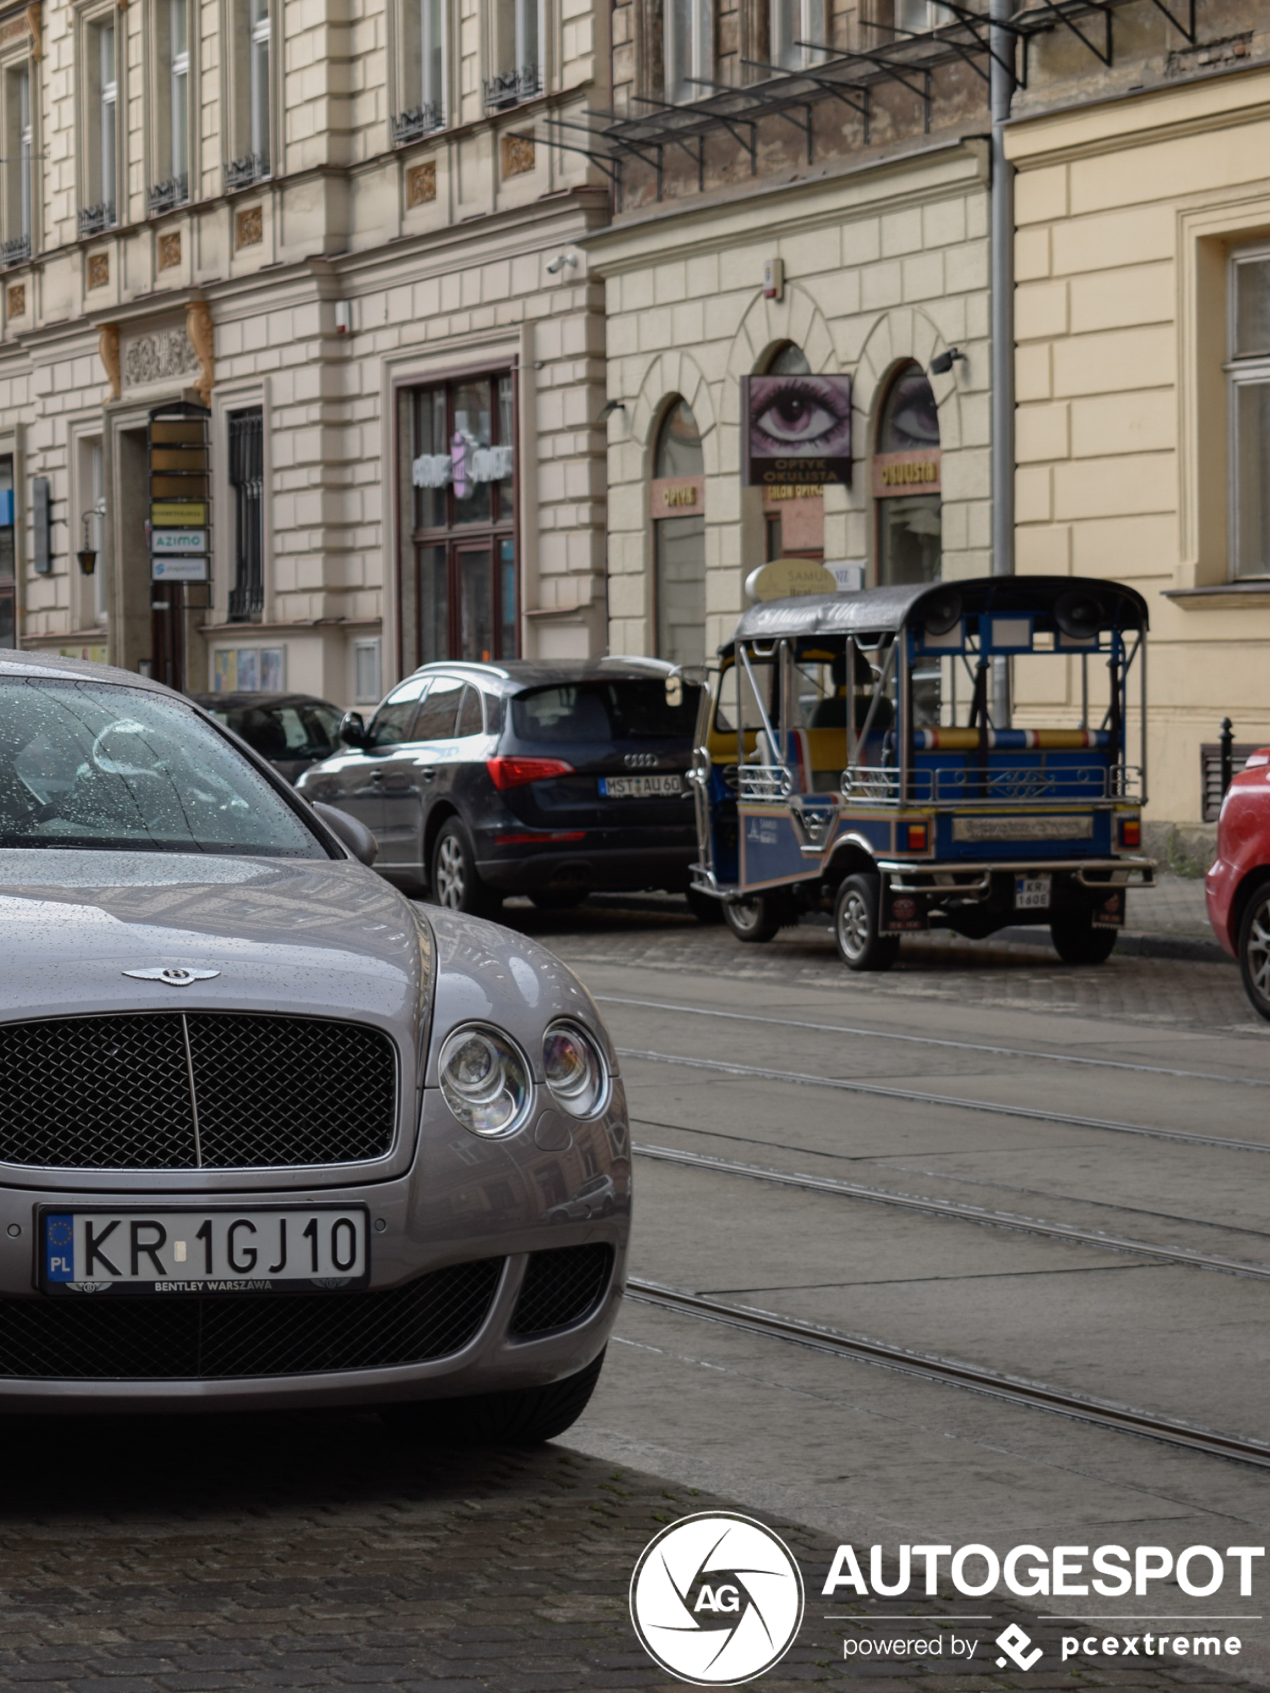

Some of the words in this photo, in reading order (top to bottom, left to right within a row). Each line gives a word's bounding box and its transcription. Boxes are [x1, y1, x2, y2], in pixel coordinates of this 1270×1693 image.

[774, 459, 825, 470] OPTYK
[763, 470, 838, 482] OKULISTA
[881, 462, 937, 486] OKULISTA
[663, 487, 696, 507] OPTYK
[607, 779, 633, 793] MST
[644, 778, 661, 791] AU
[663, 777, 680, 791] 60
[1026, 881, 1042, 892] KR
[1019, 893, 1047, 905] 160E
[84, 1219, 168, 1277] KR
[195, 1217, 358, 1276] 1GJ10
[50, 1256, 71, 1273] PL
[155, 1281, 205, 1292] BENTLEY
[206, 1279, 273, 1292] WARSZAWA
